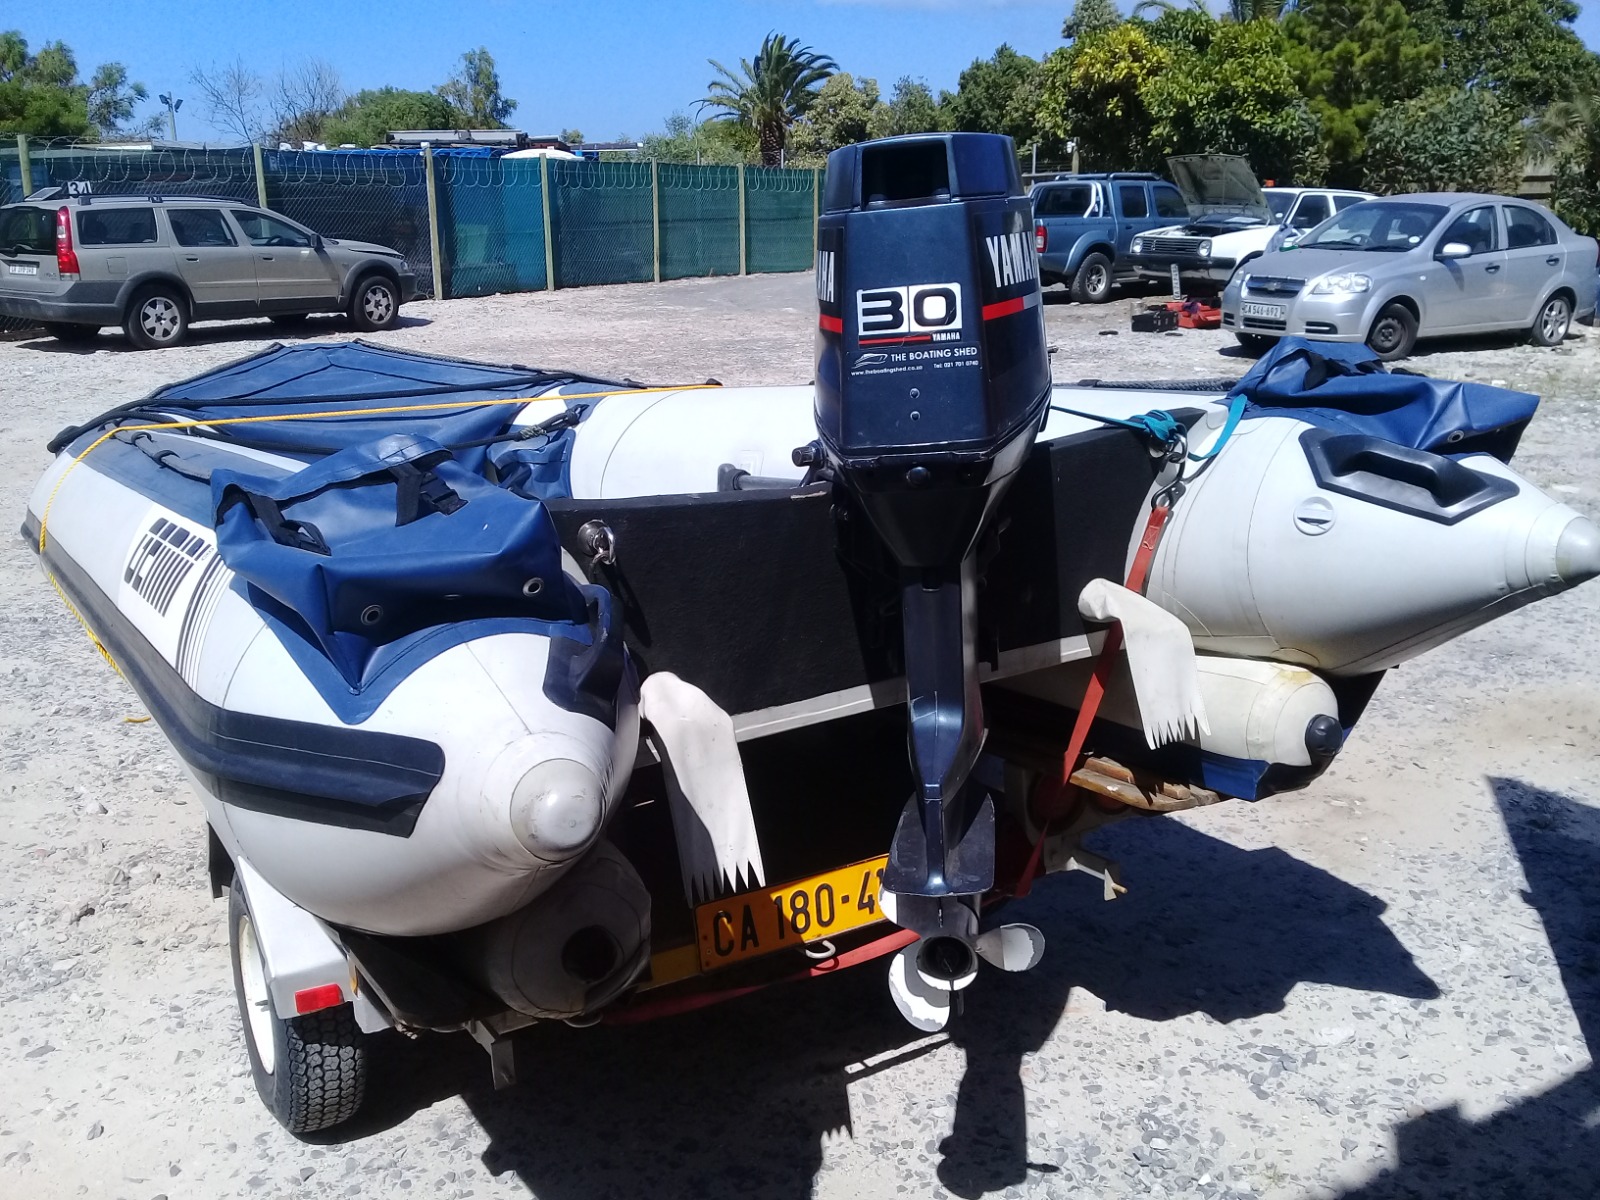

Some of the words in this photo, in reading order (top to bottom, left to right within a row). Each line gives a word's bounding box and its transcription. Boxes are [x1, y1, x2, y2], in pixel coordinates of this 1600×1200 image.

[862, 288, 957, 332] 30
[932, 332, 961, 341] YAMAHA
[891, 354, 907, 362] THE
[909, 349, 951, 361] BOATING
[954, 347, 978, 357] SHED
[713, 904, 760, 957] CA
